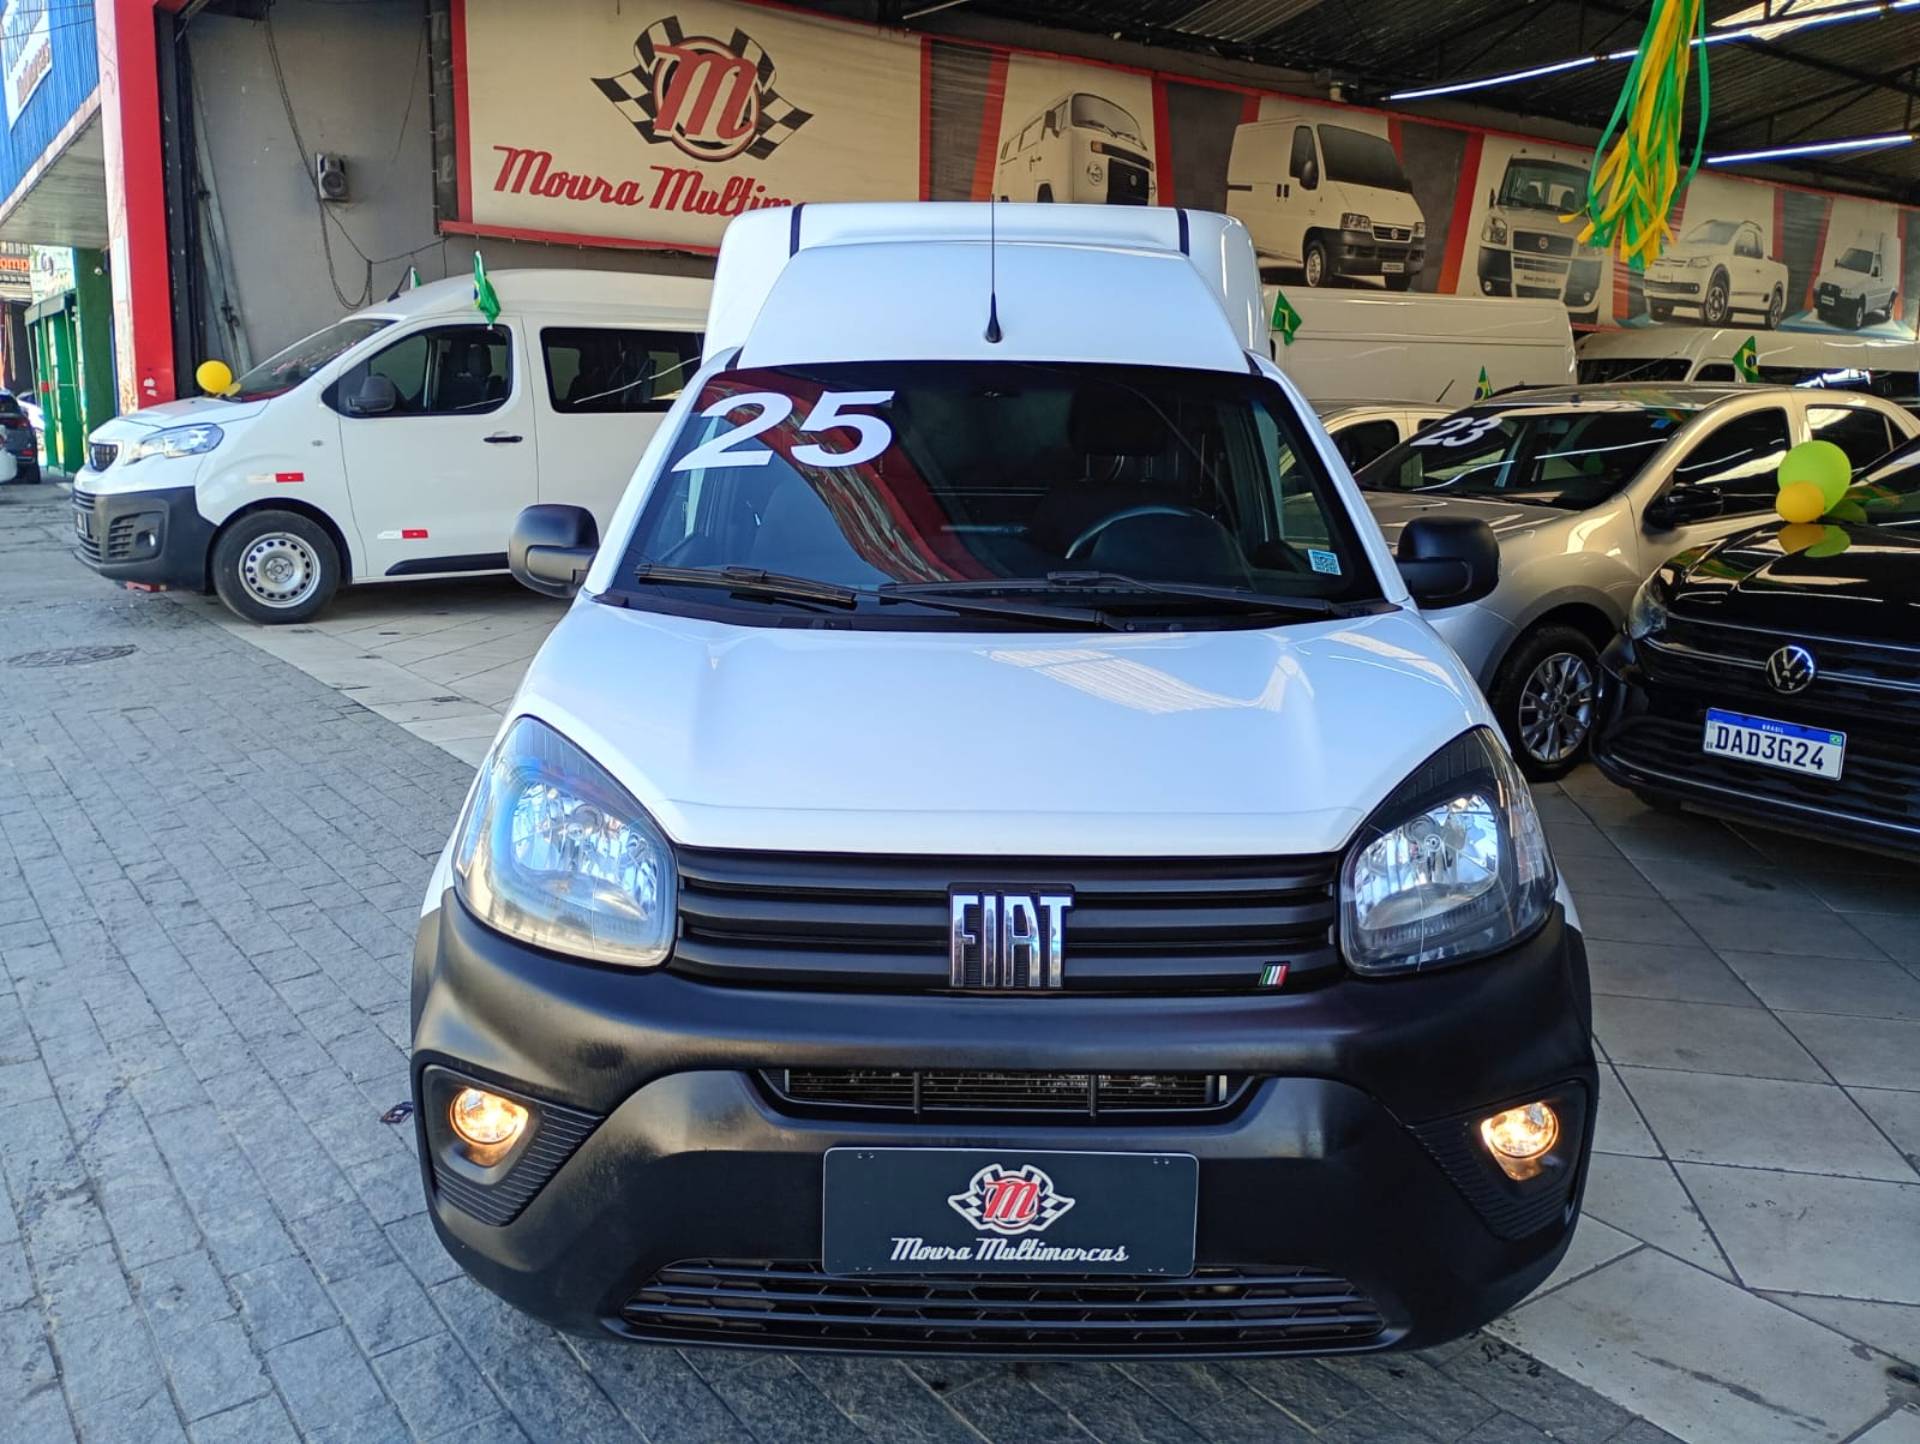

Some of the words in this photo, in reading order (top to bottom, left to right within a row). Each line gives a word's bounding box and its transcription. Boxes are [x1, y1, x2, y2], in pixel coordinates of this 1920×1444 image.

[493, 145, 644, 206] Moura
[671, 390, 896, 472] 25
[1410, 416, 1503, 447] 23
[1714, 725, 1825, 771] DAD3G24
[952, 894, 1073, 988] FIAT
[890, 1237, 972, 1261] Moura
[975, 1237, 1129, 1262] Multimarcas
